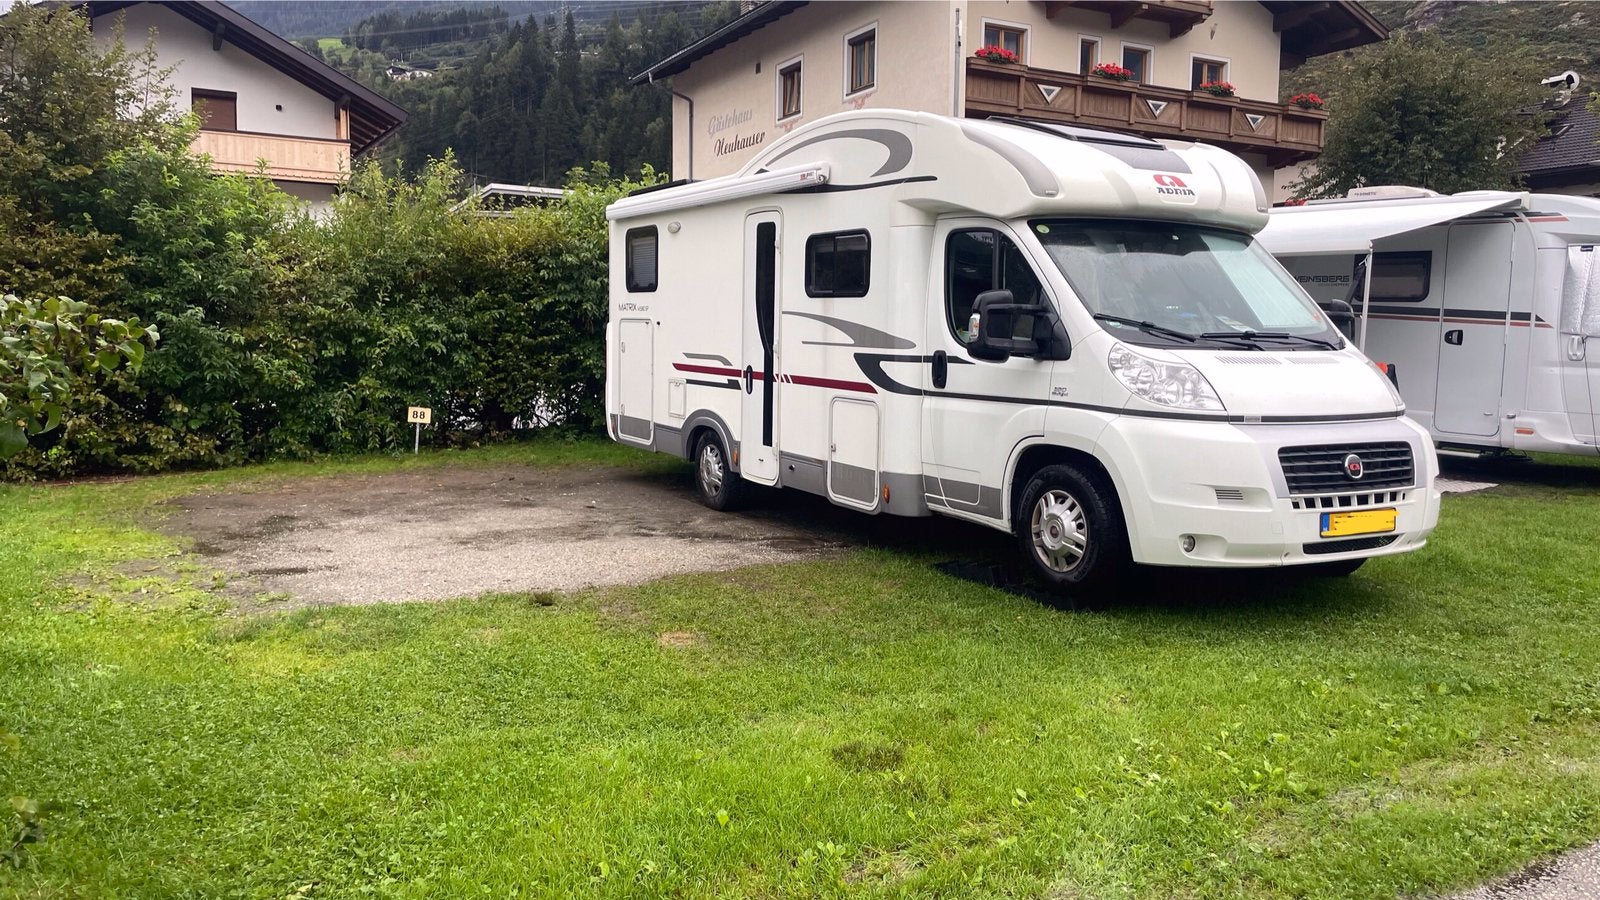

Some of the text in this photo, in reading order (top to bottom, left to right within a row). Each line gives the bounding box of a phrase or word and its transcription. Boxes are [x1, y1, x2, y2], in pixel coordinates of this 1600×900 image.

[714, 132, 765, 157] Neuhauser
[1156, 186, 1195, 196] ADRIA
[618, 302, 637, 311] MATRIX
[412, 410, 425, 419] 88
